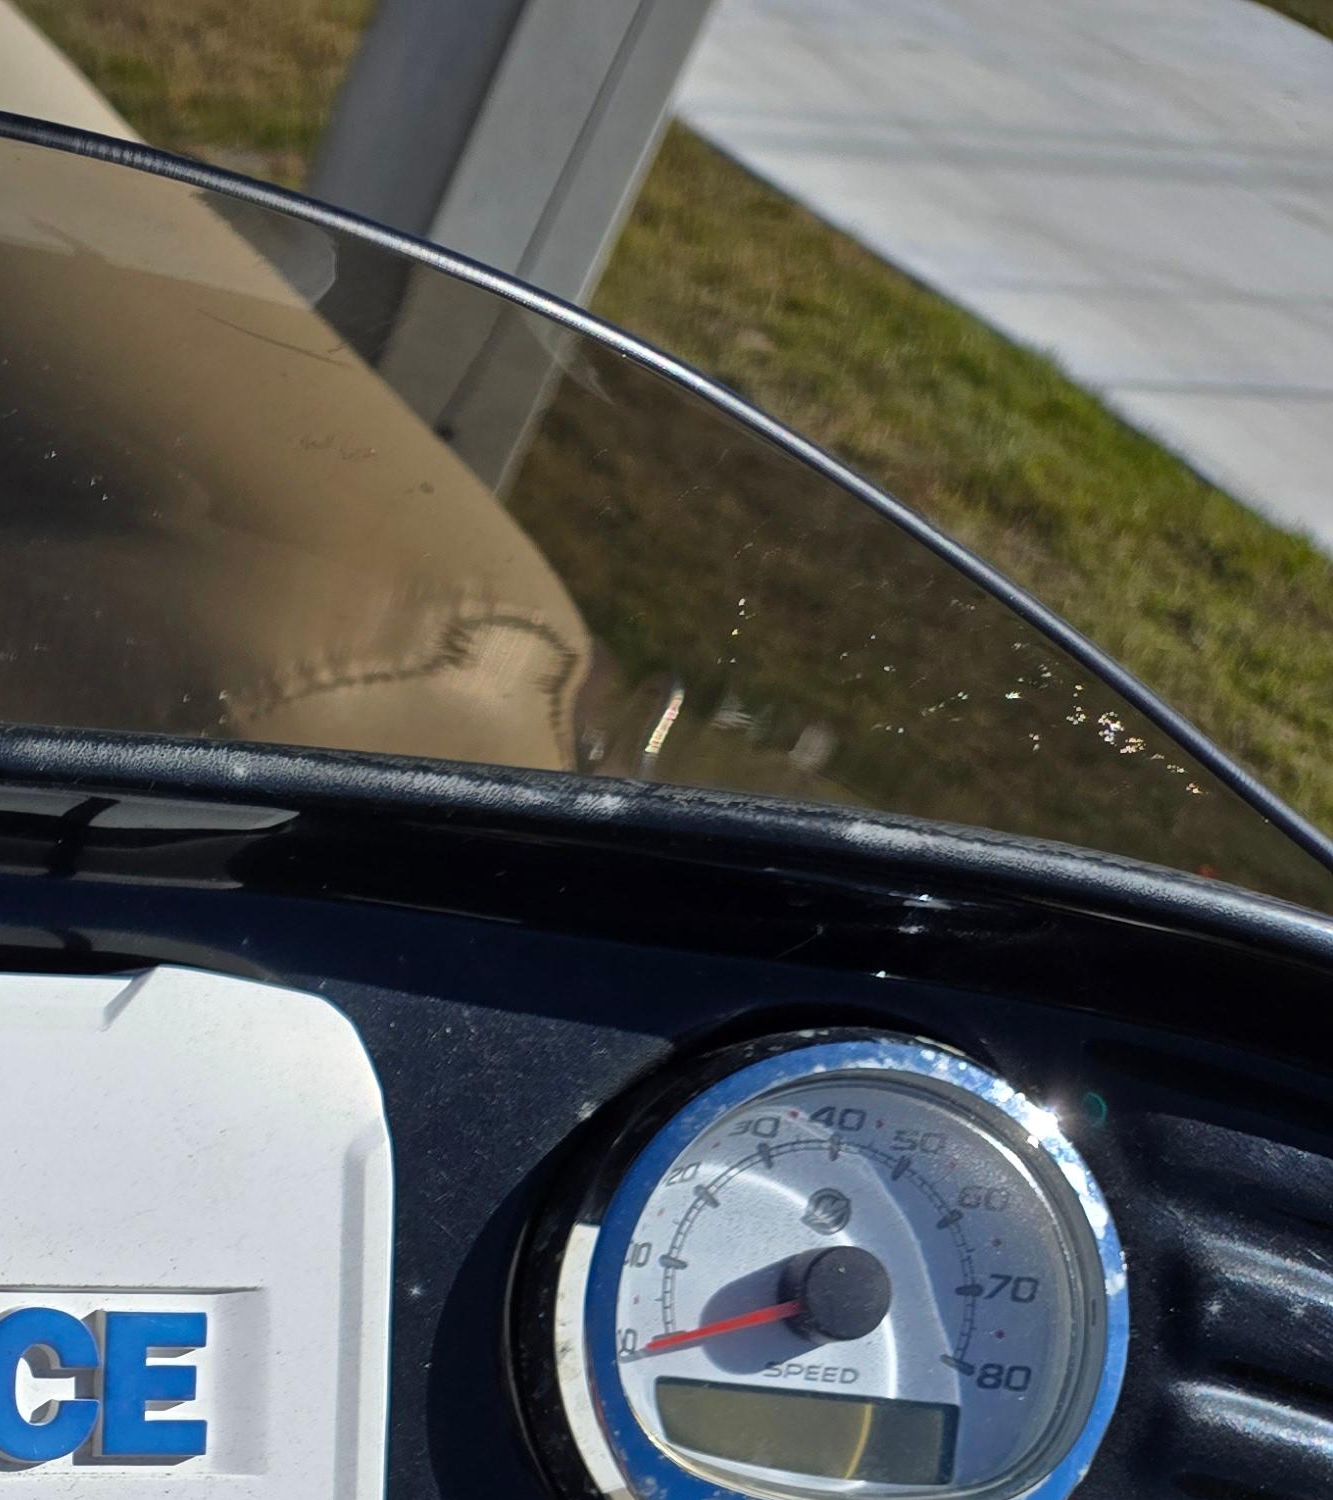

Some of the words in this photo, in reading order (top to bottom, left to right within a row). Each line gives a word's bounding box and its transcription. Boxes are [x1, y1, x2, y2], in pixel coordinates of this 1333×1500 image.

[809, 1106, 867, 1132] 40
[893, 1130, 947, 1155] 50
[982, 1274, 1040, 1304] 70
[763, 1361, 860, 1385] SPEED
[976, 1362, 1032, 1392] 80
